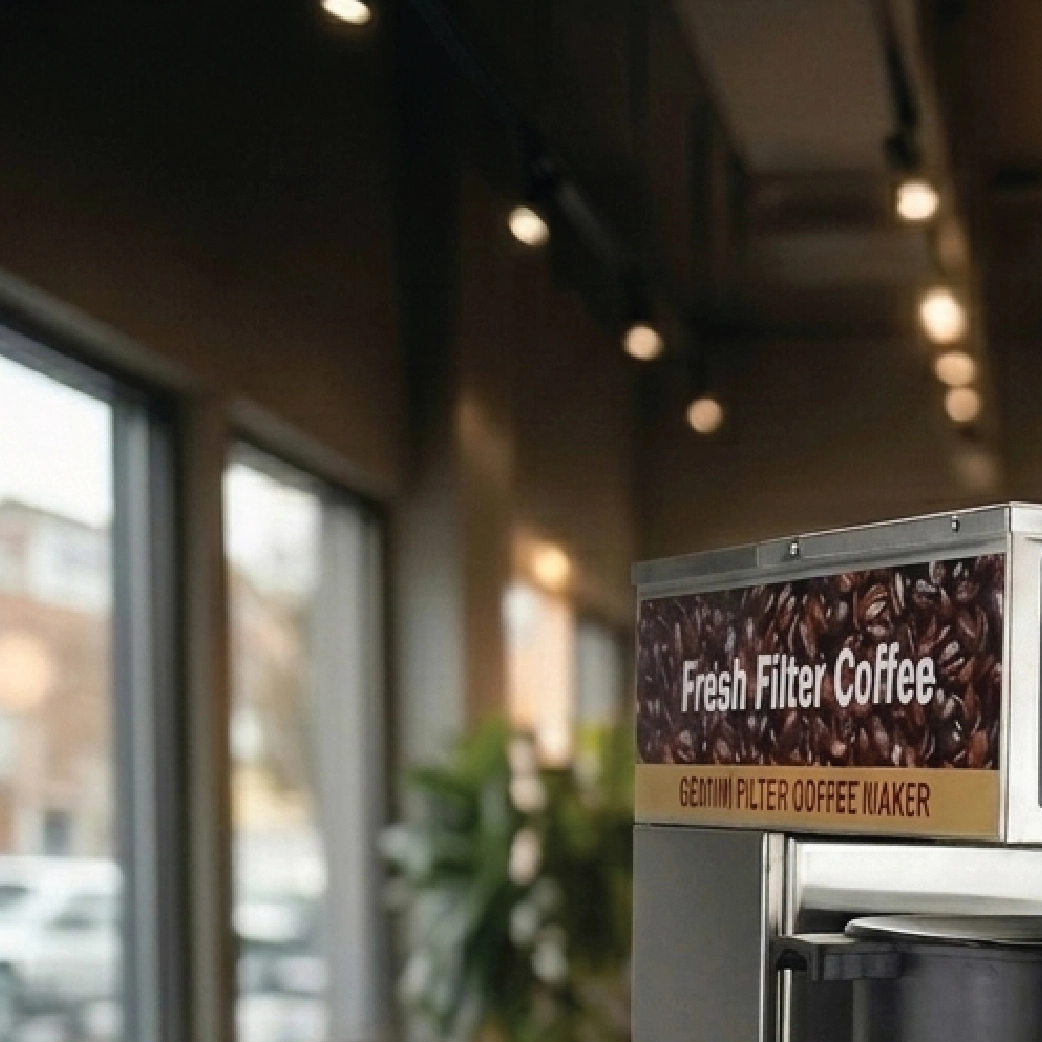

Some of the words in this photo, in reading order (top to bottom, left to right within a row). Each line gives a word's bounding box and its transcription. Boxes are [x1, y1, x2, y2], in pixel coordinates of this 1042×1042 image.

[680, 659, 747, 712] Fresh
[755, 653, 826, 710] Filter
[833, 642, 936, 708] Coffee
[863, 780, 931, 818] MAKER
